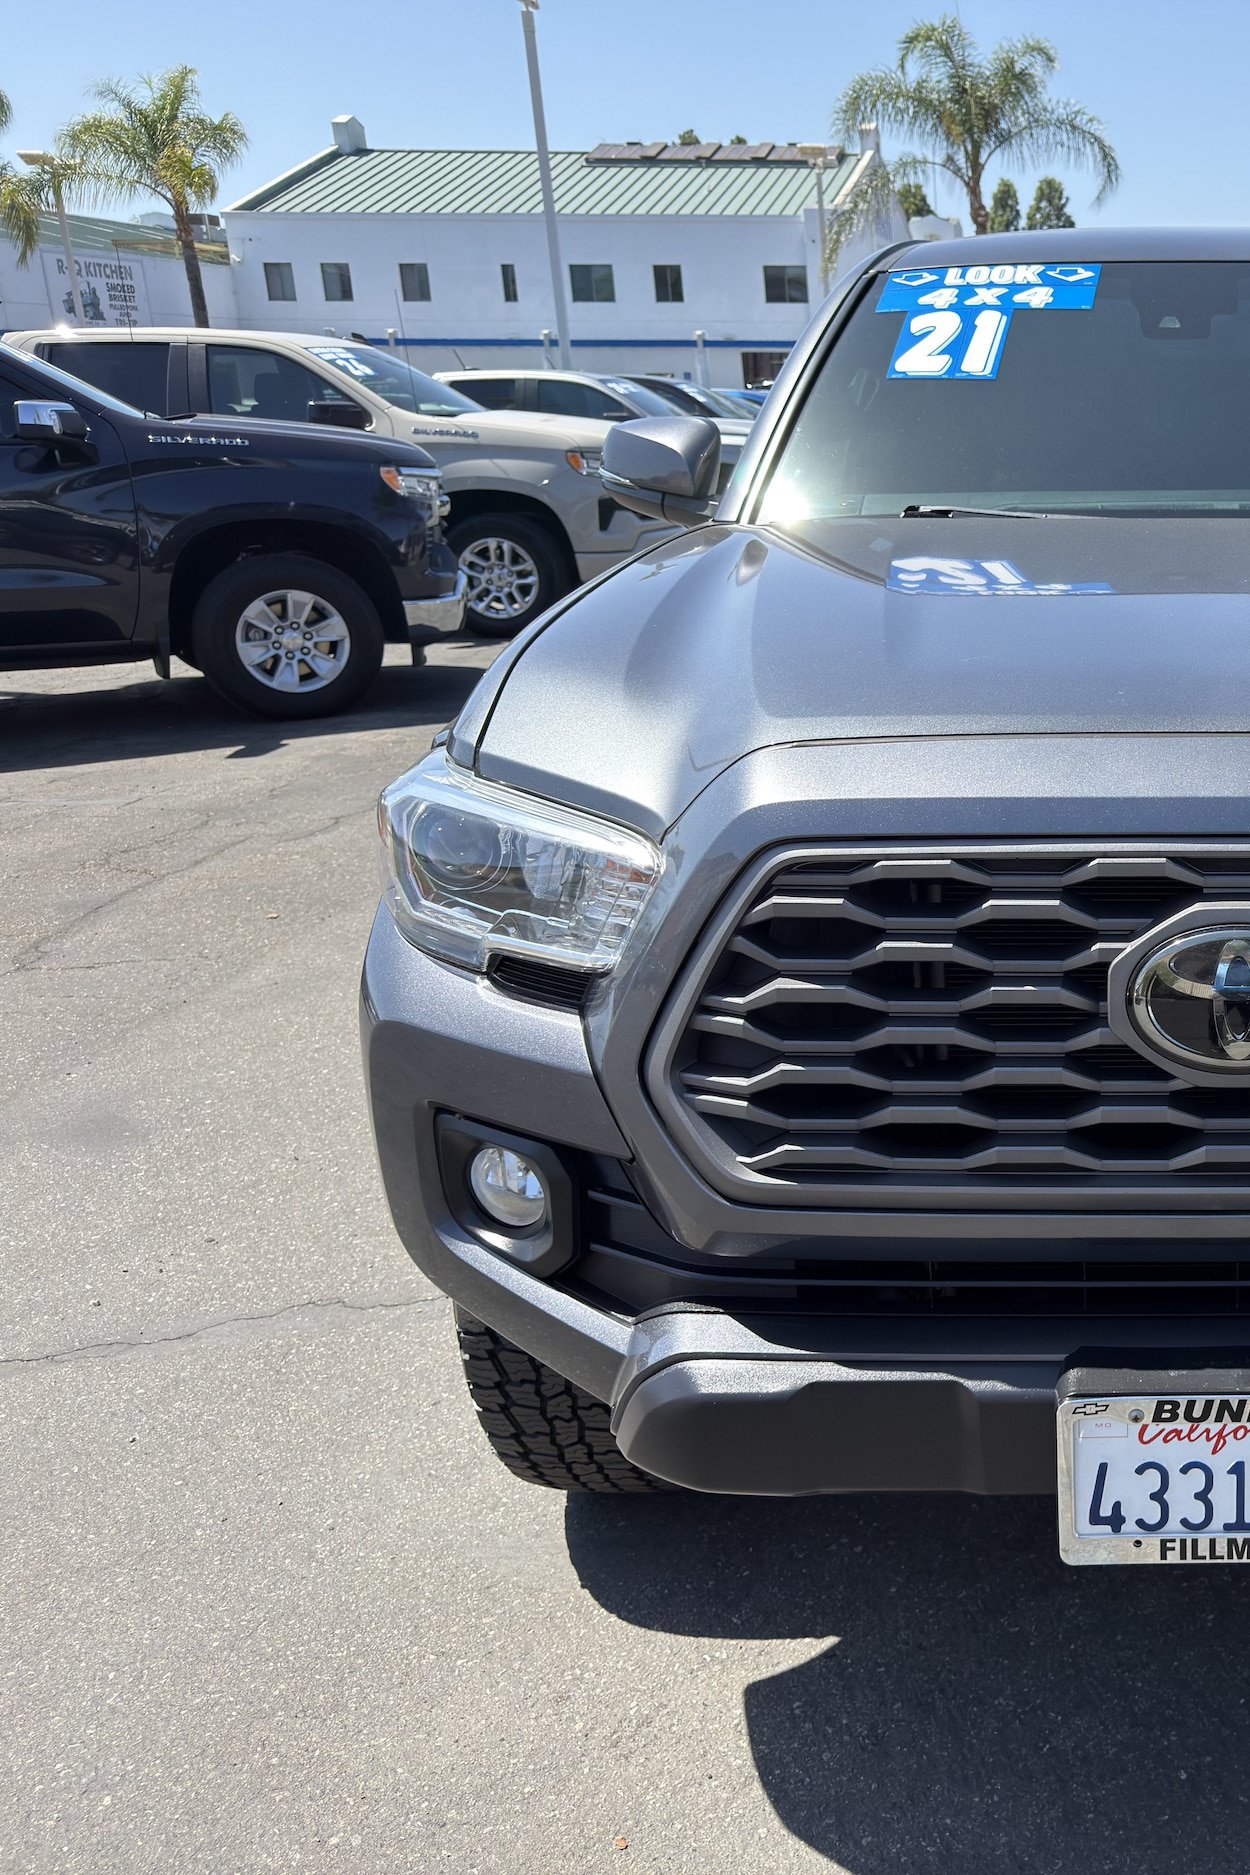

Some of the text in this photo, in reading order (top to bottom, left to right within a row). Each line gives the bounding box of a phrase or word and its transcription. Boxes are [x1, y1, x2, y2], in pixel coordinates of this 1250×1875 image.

[84, 261, 134, 280] KITCHEN
[943, 264, 1046, 286] LOOK
[105, 282, 136, 294] SMOKED
[108, 293, 136, 303] BRISKET
[894, 309, 1007, 376] 21
[148, 434, 250, 446] SILVERADO
